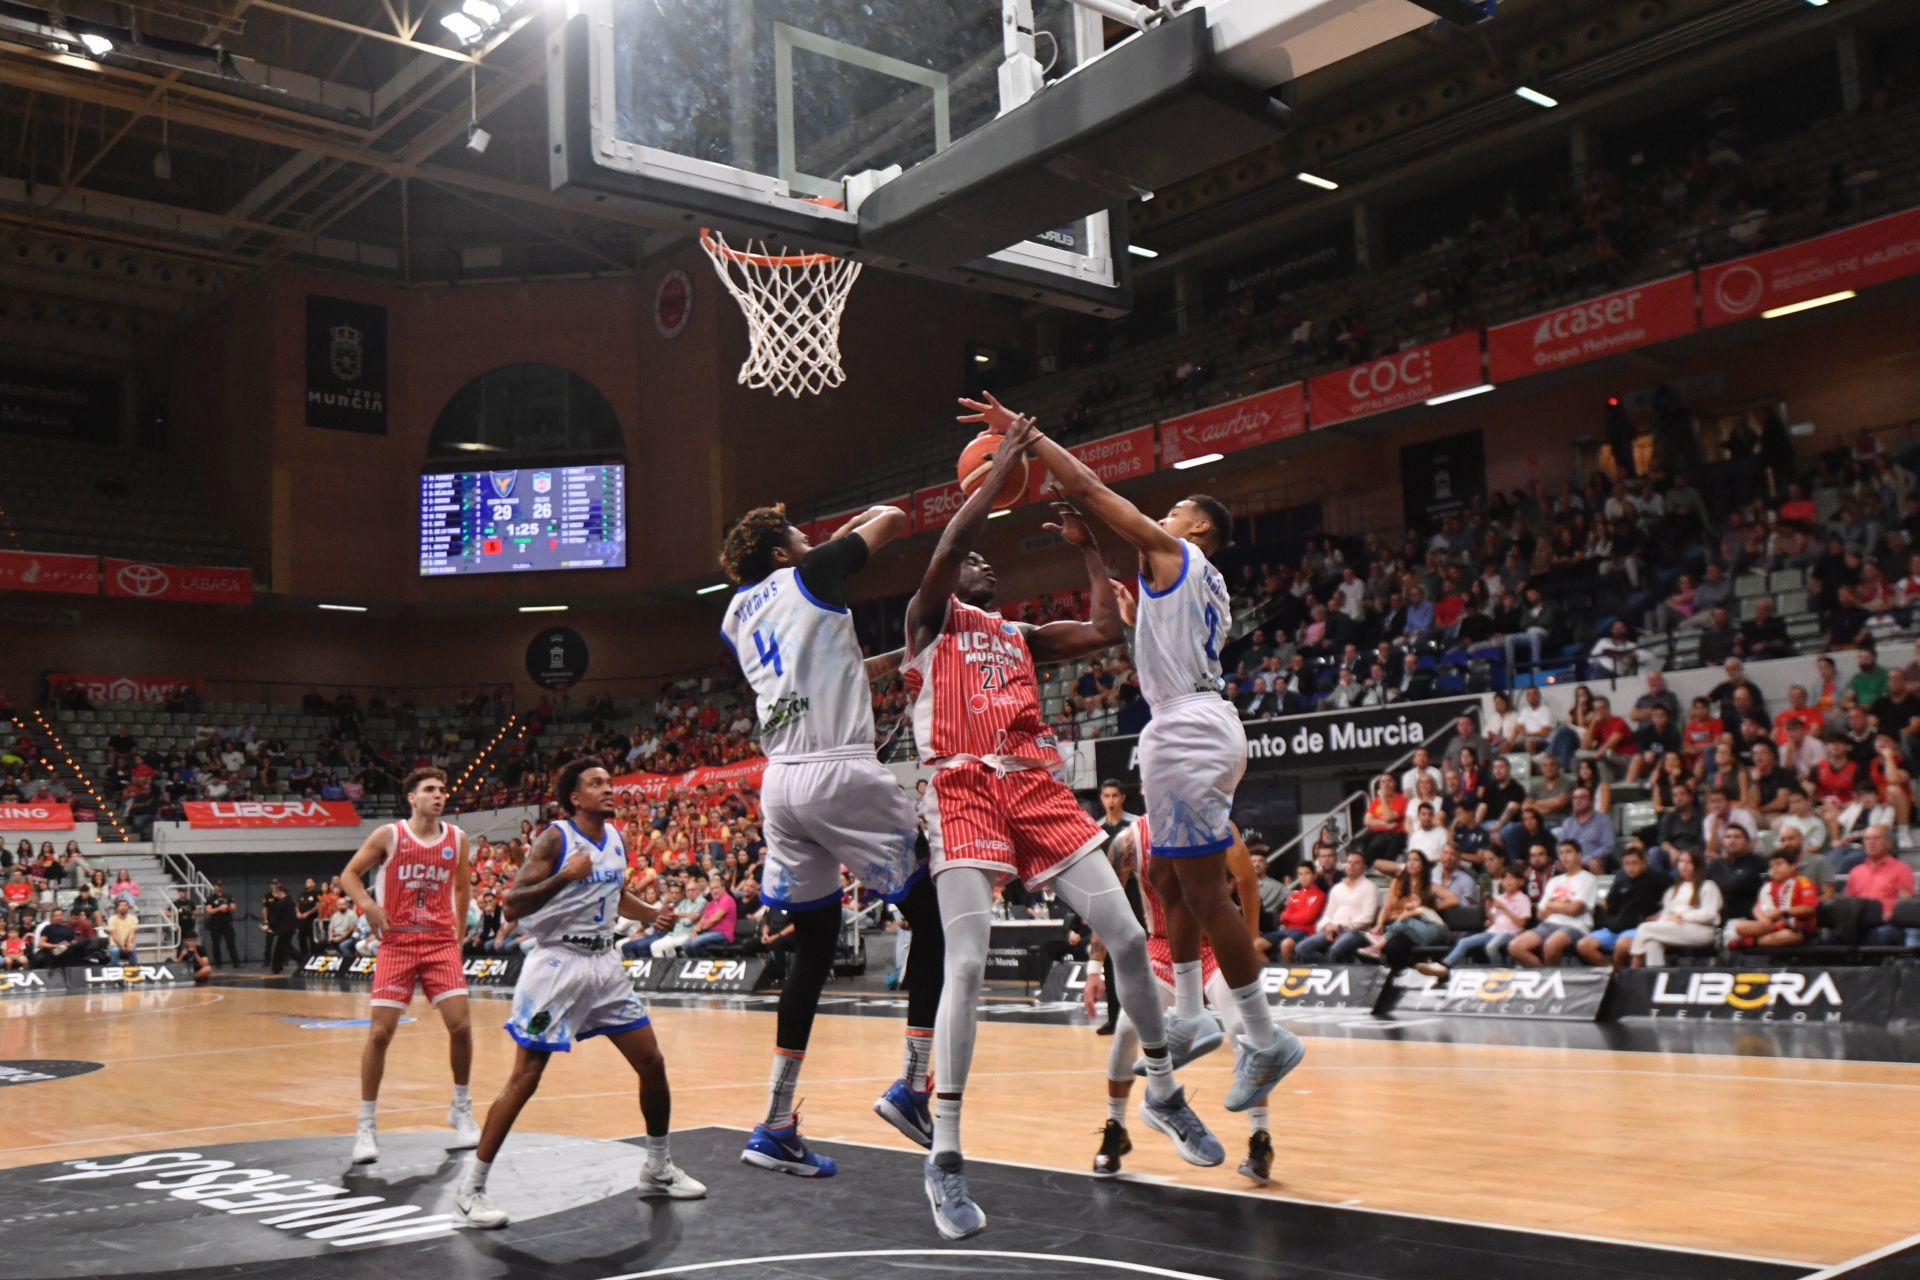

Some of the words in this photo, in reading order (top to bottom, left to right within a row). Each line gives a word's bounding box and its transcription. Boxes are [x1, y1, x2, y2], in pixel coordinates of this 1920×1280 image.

[1552, 292, 1642, 338] caser
[308, 391, 383, 412] MURCIA
[1080, 439, 1132, 461] Asterra
[1098, 462, 1141, 483] rtners
[493, 504, 512, 521] 29
[532, 502, 552, 519] 26
[507, 523, 540, 536] 1:25
[753, 629, 784, 678] 4
[957, 630, 1023, 663] UCAM
[965, 652, 1018, 670] MURCIA
[979, 665, 1006, 690] 21
[1291, 727, 1324, 754] de
[1330, 716, 1424, 750] Murcia
[398, 863, 450, 884] UCAM
[996, 956, 1019, 967] Murcia
[1652, 971, 1843, 1010] LIBERA
[1648, 1008, 1842, 1025] TELECOM
